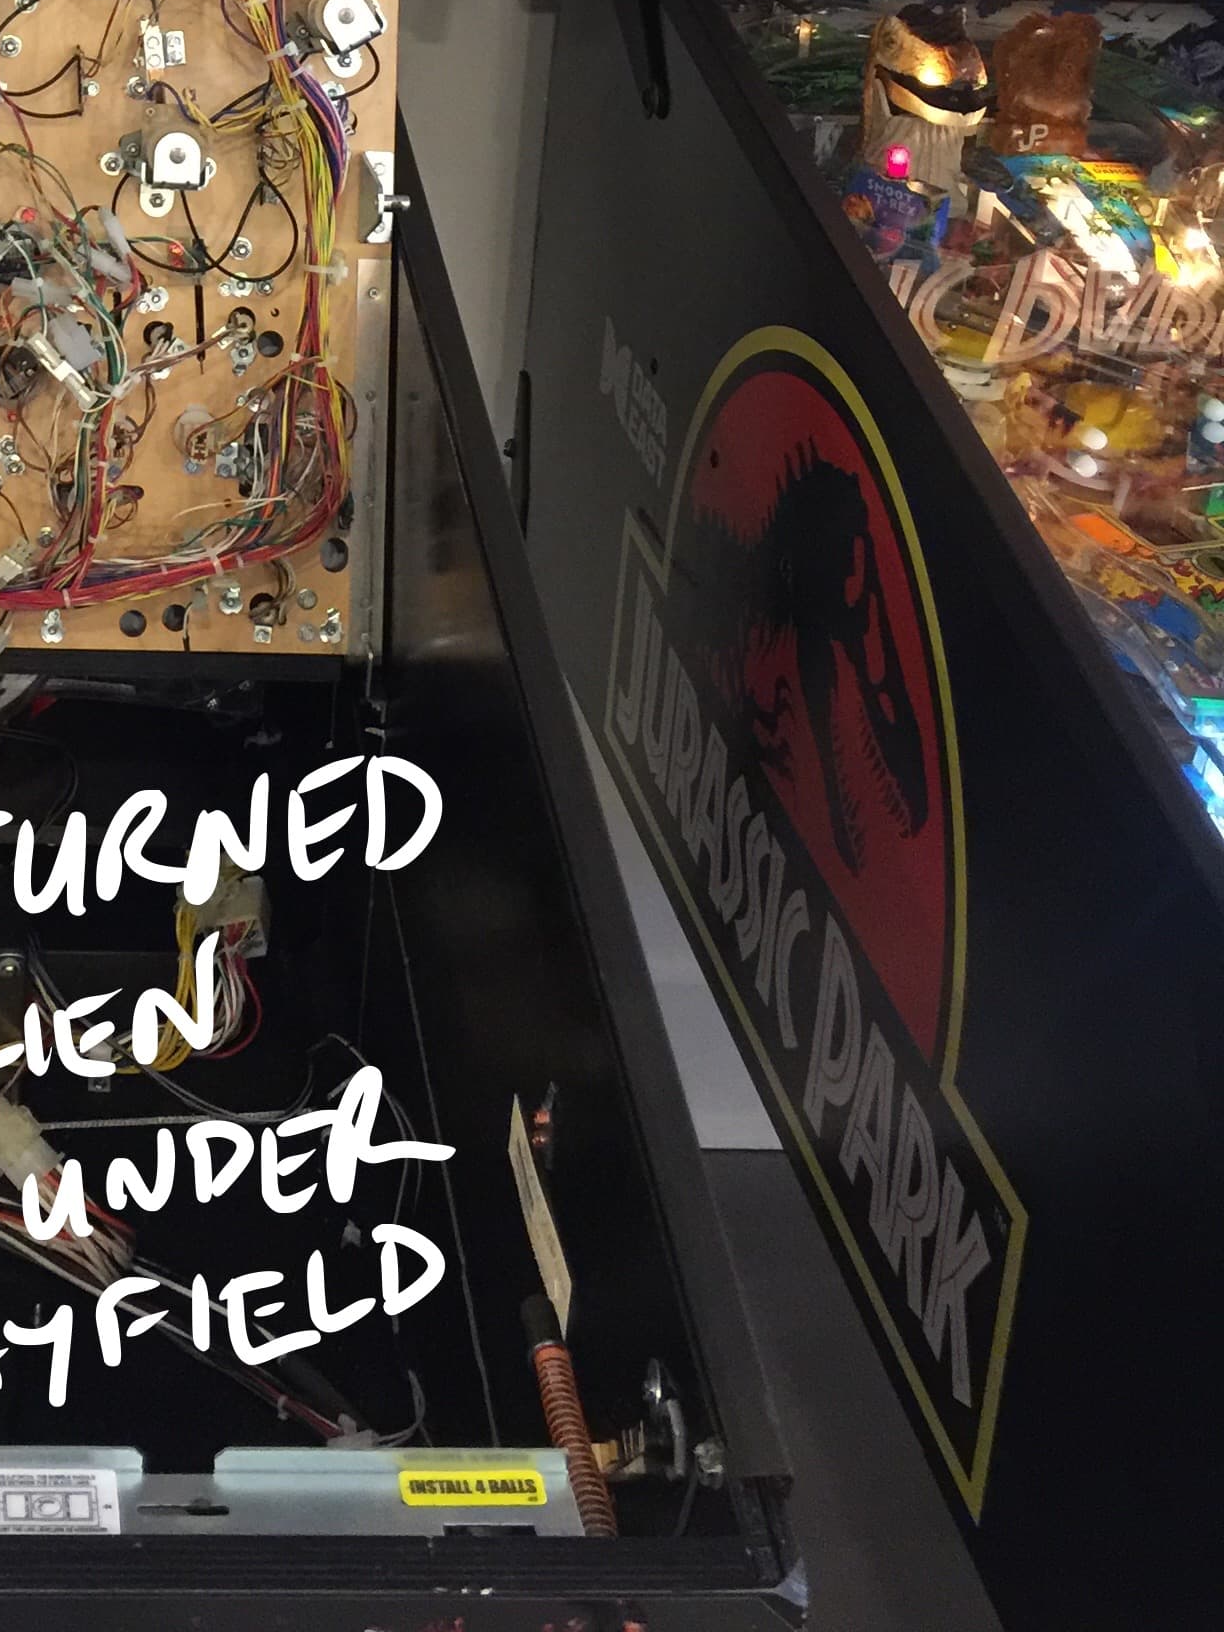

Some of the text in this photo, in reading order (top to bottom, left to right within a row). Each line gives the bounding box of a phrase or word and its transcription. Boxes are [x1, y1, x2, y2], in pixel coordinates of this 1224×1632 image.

[866, 178, 914, 203] SHOOT
[874, 192, 918, 217] T-REX
[614, 563, 991, 1409] JURASSIC PARK
[408, 1478, 538, 1494] INSTALL 4 BALLS
